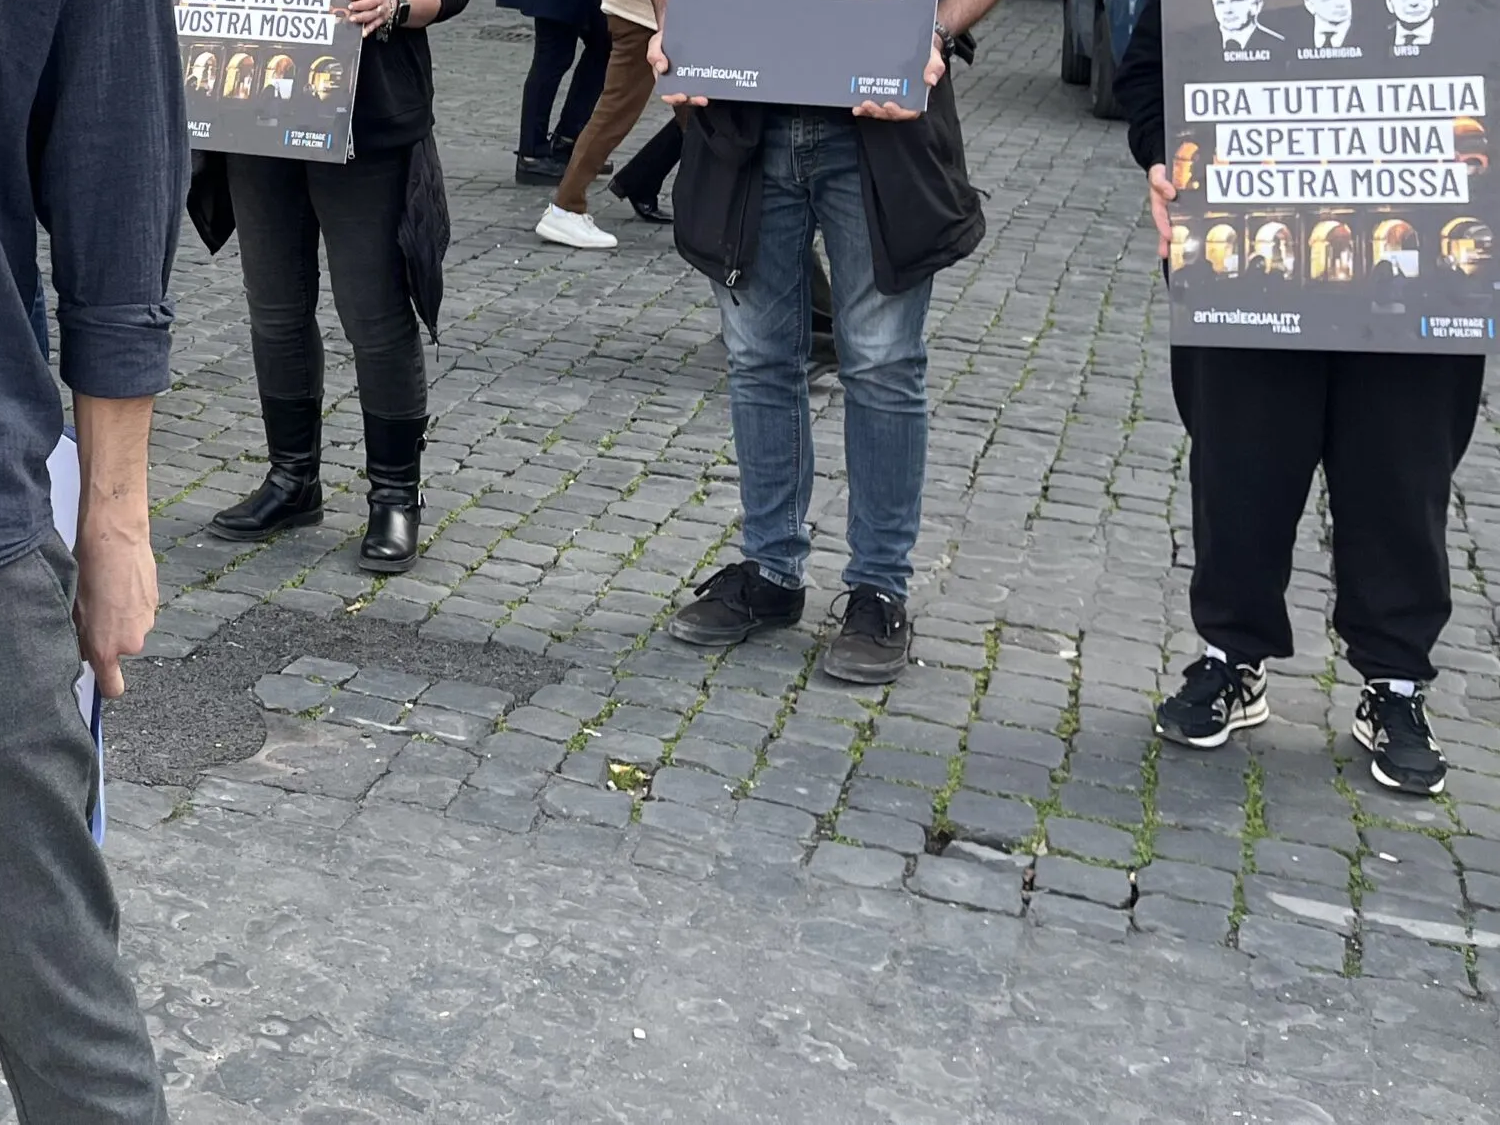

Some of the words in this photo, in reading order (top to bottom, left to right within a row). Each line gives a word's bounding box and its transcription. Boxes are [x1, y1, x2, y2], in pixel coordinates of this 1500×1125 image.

[179, 10, 252, 36] VOSTRA
[258, 14, 329, 41] MOSSA
[1224, 50, 1270, 62] SCHILLACI
[677, 65, 759, 81] animalEQUALITY
[858, 77, 873, 86] STOP
[736, 79, 758, 88] ITALIA
[1191, 89, 1252, 116] ORA
[1263, 86, 1366, 115] TUTTA
[1377, 82, 1480, 112] ITALIA
[1226, 127, 1367, 156] ASPETTA
[1378, 126, 1445, 155] UNA
[1215, 169, 1339, 198] VOSTRA
[1351, 168, 1461, 197] MOSSA
[1193, 308, 1301, 326] animalEQUALITY
[1272, 325, 1301, 334] ITALIA
